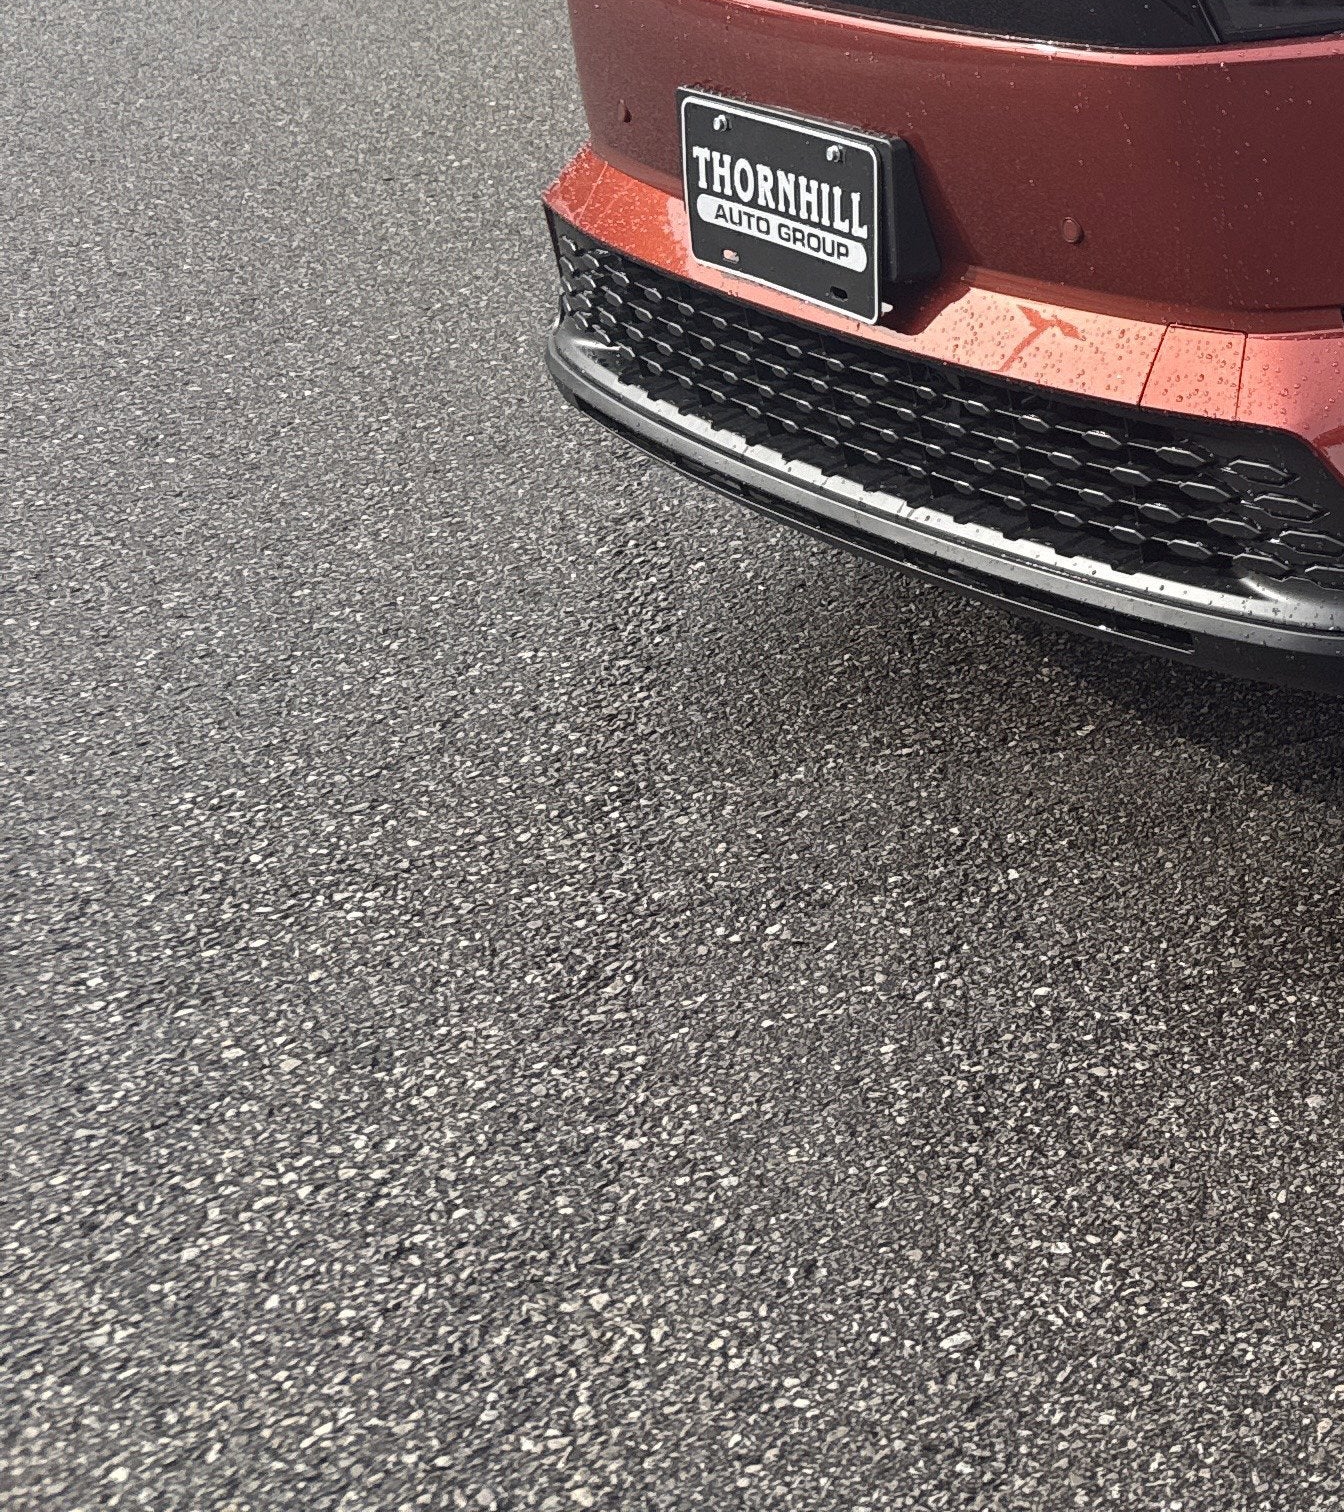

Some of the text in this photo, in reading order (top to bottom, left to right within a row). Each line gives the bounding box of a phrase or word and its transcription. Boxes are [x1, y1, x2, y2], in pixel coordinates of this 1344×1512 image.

[692, 145, 868, 240] THORNHILL
[714, 203, 849, 261] AUTO GROUP
